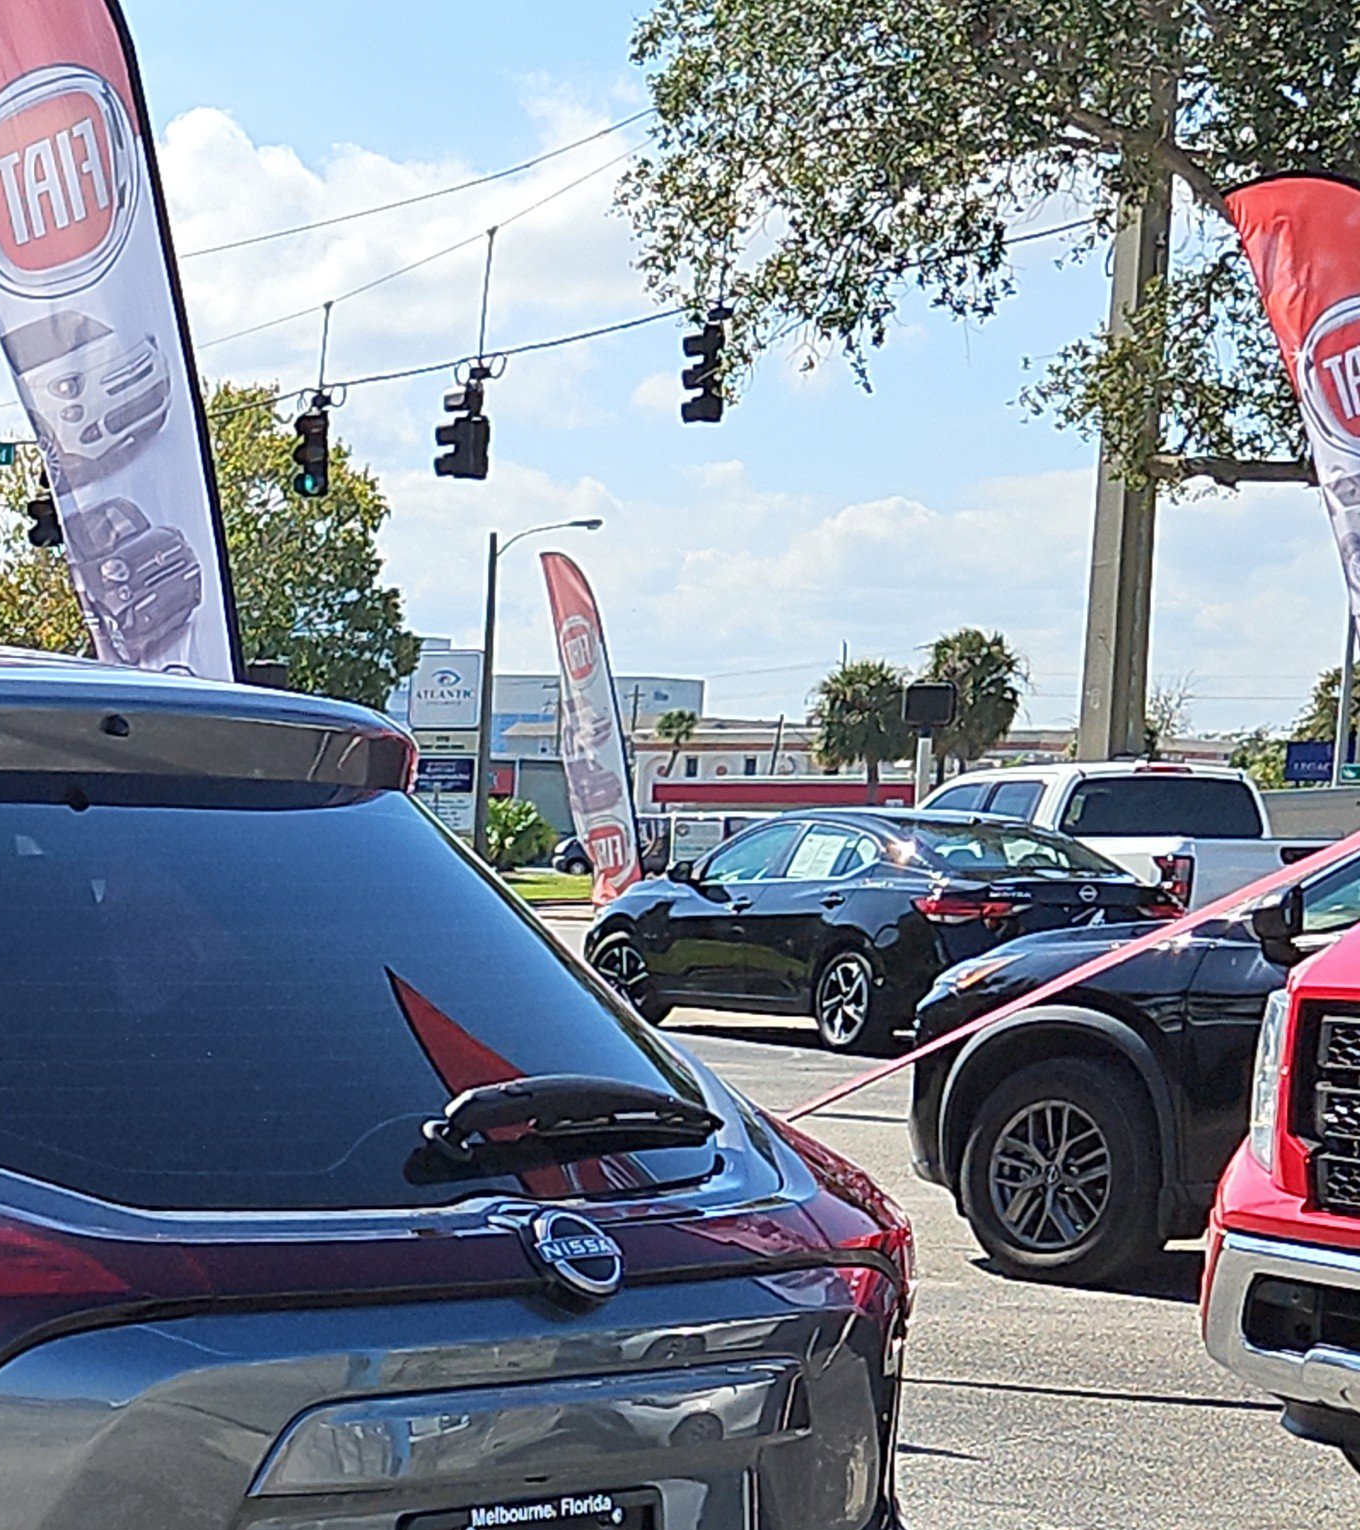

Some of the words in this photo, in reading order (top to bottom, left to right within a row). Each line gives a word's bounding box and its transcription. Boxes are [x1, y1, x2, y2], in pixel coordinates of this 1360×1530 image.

[416, 689, 474, 700] ATLANTIC
[542, 1238, 612, 1259] NISSA
[470, 1503, 557, 1528] Melbourne,
[561, 1494, 612, 1517] Florida
